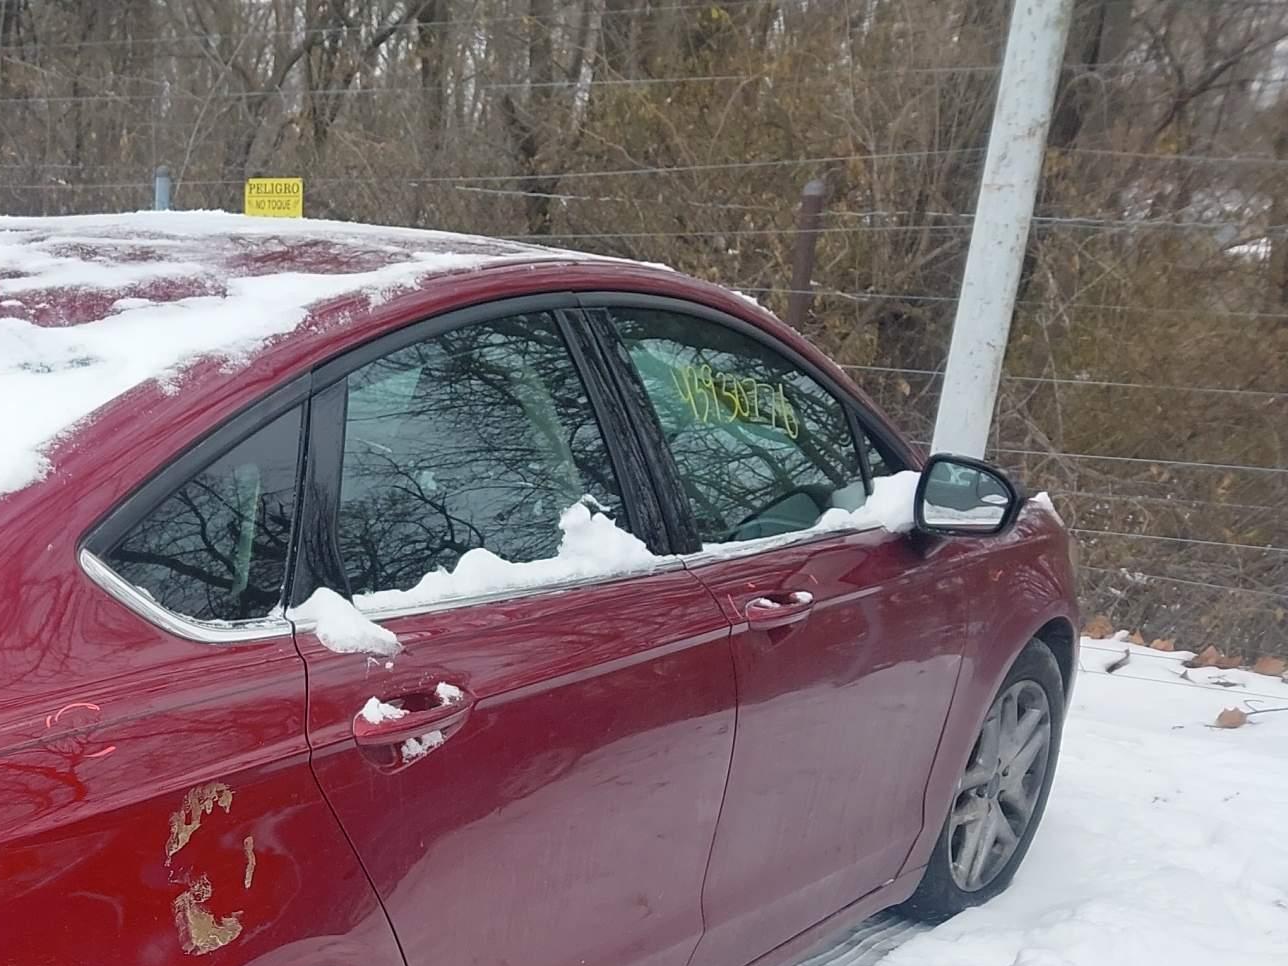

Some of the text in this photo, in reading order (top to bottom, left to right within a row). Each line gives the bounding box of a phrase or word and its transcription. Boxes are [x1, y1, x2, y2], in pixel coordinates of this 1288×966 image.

[248, 183, 300, 194] PELIGRO
[255, 199, 292, 210] NO TOQUE
[670, 364, 799, 439] 43930776
